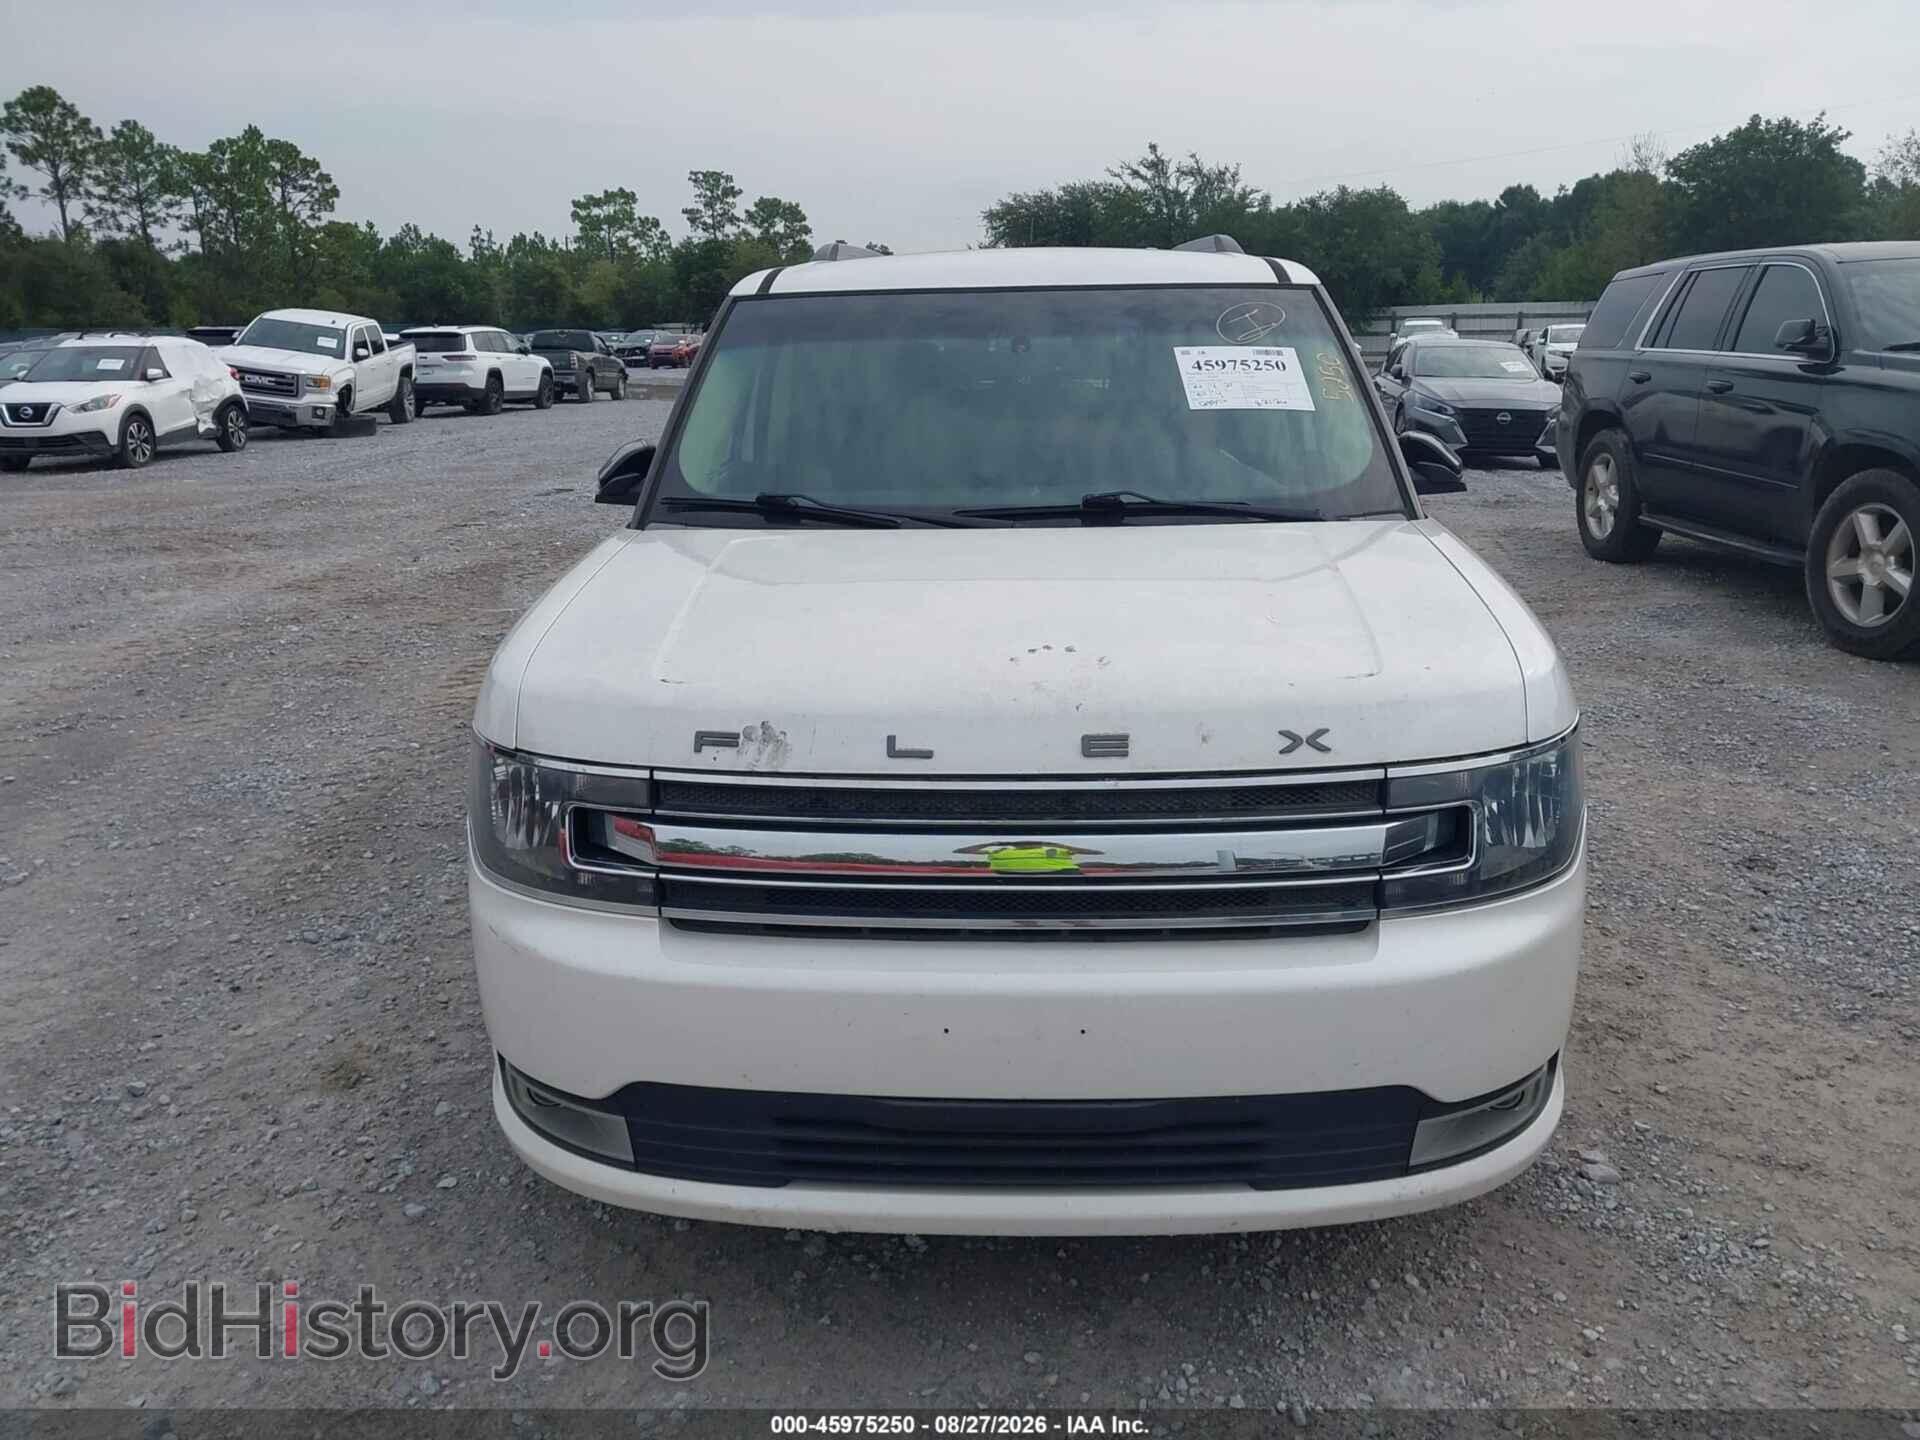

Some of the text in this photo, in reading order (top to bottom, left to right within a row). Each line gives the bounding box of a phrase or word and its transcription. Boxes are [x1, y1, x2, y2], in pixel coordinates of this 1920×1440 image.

[1191, 359, 1287, 372] 45975250
[244, 374, 277, 386] GMC
[693, 728, 1332, 759] FLEX
